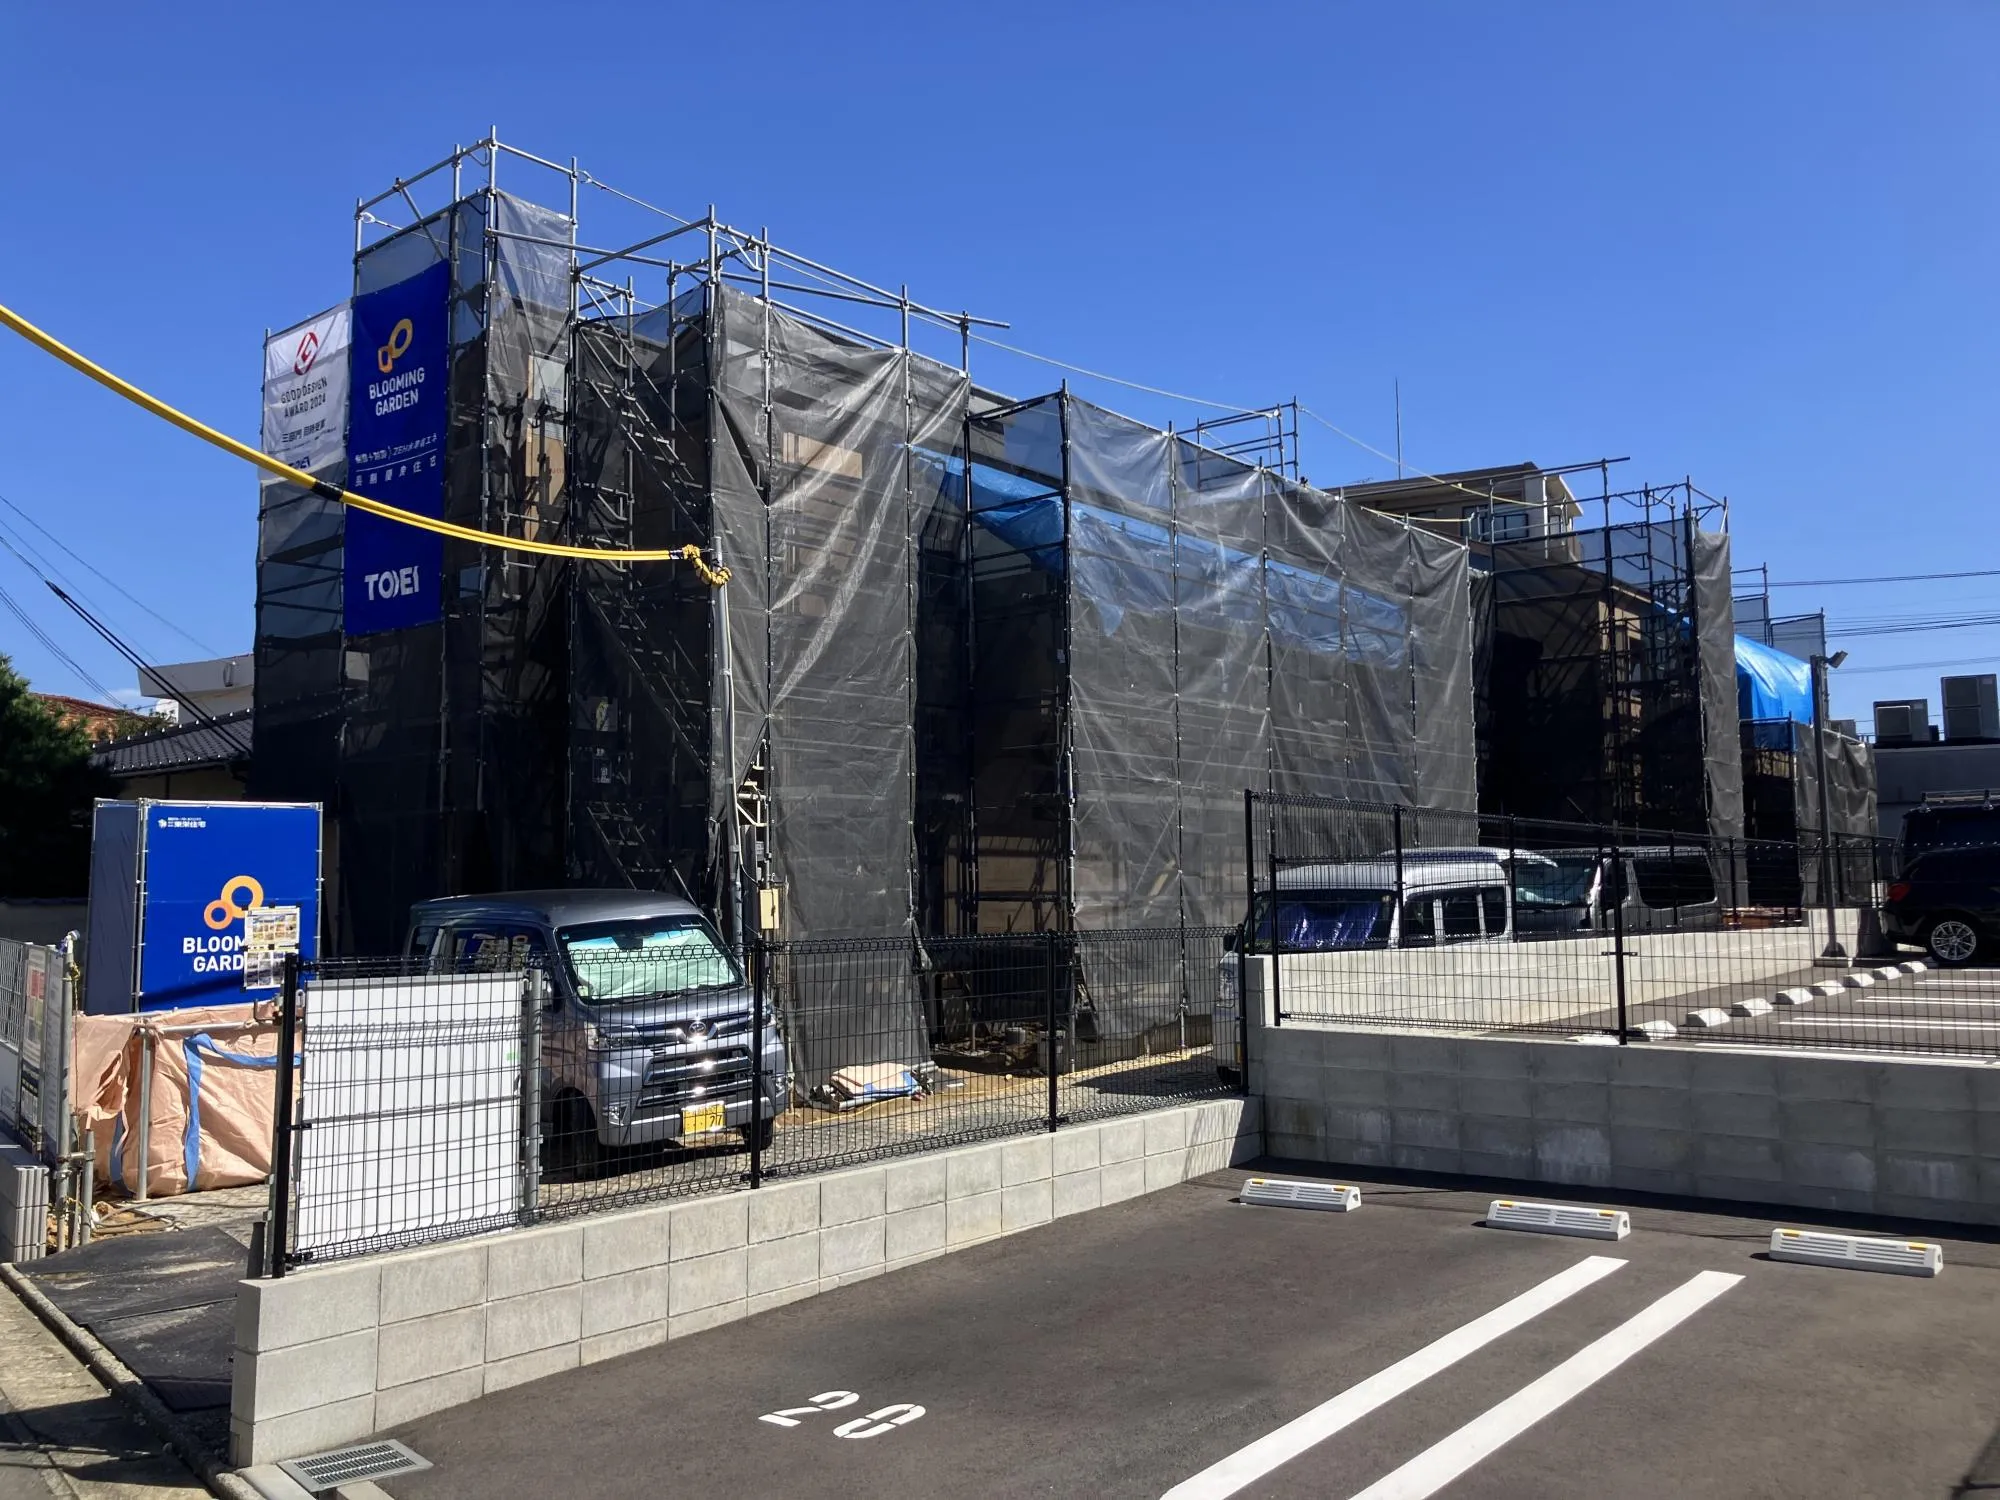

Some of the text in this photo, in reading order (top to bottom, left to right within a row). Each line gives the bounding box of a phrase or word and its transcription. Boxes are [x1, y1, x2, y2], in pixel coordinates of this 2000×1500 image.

[281, 376, 328, 404] GOOD DESIGN
[369, 367, 425, 399] BLOOMING
[284, 393, 326, 418] AWARD 2024
[375, 388, 419, 416] GARDEN
[364, 566, 419, 601] TOEI
[183, 936, 245, 954] BLOOM
[193, 954, 244, 972] GARD
[758, 1390, 926, 1438] 20
